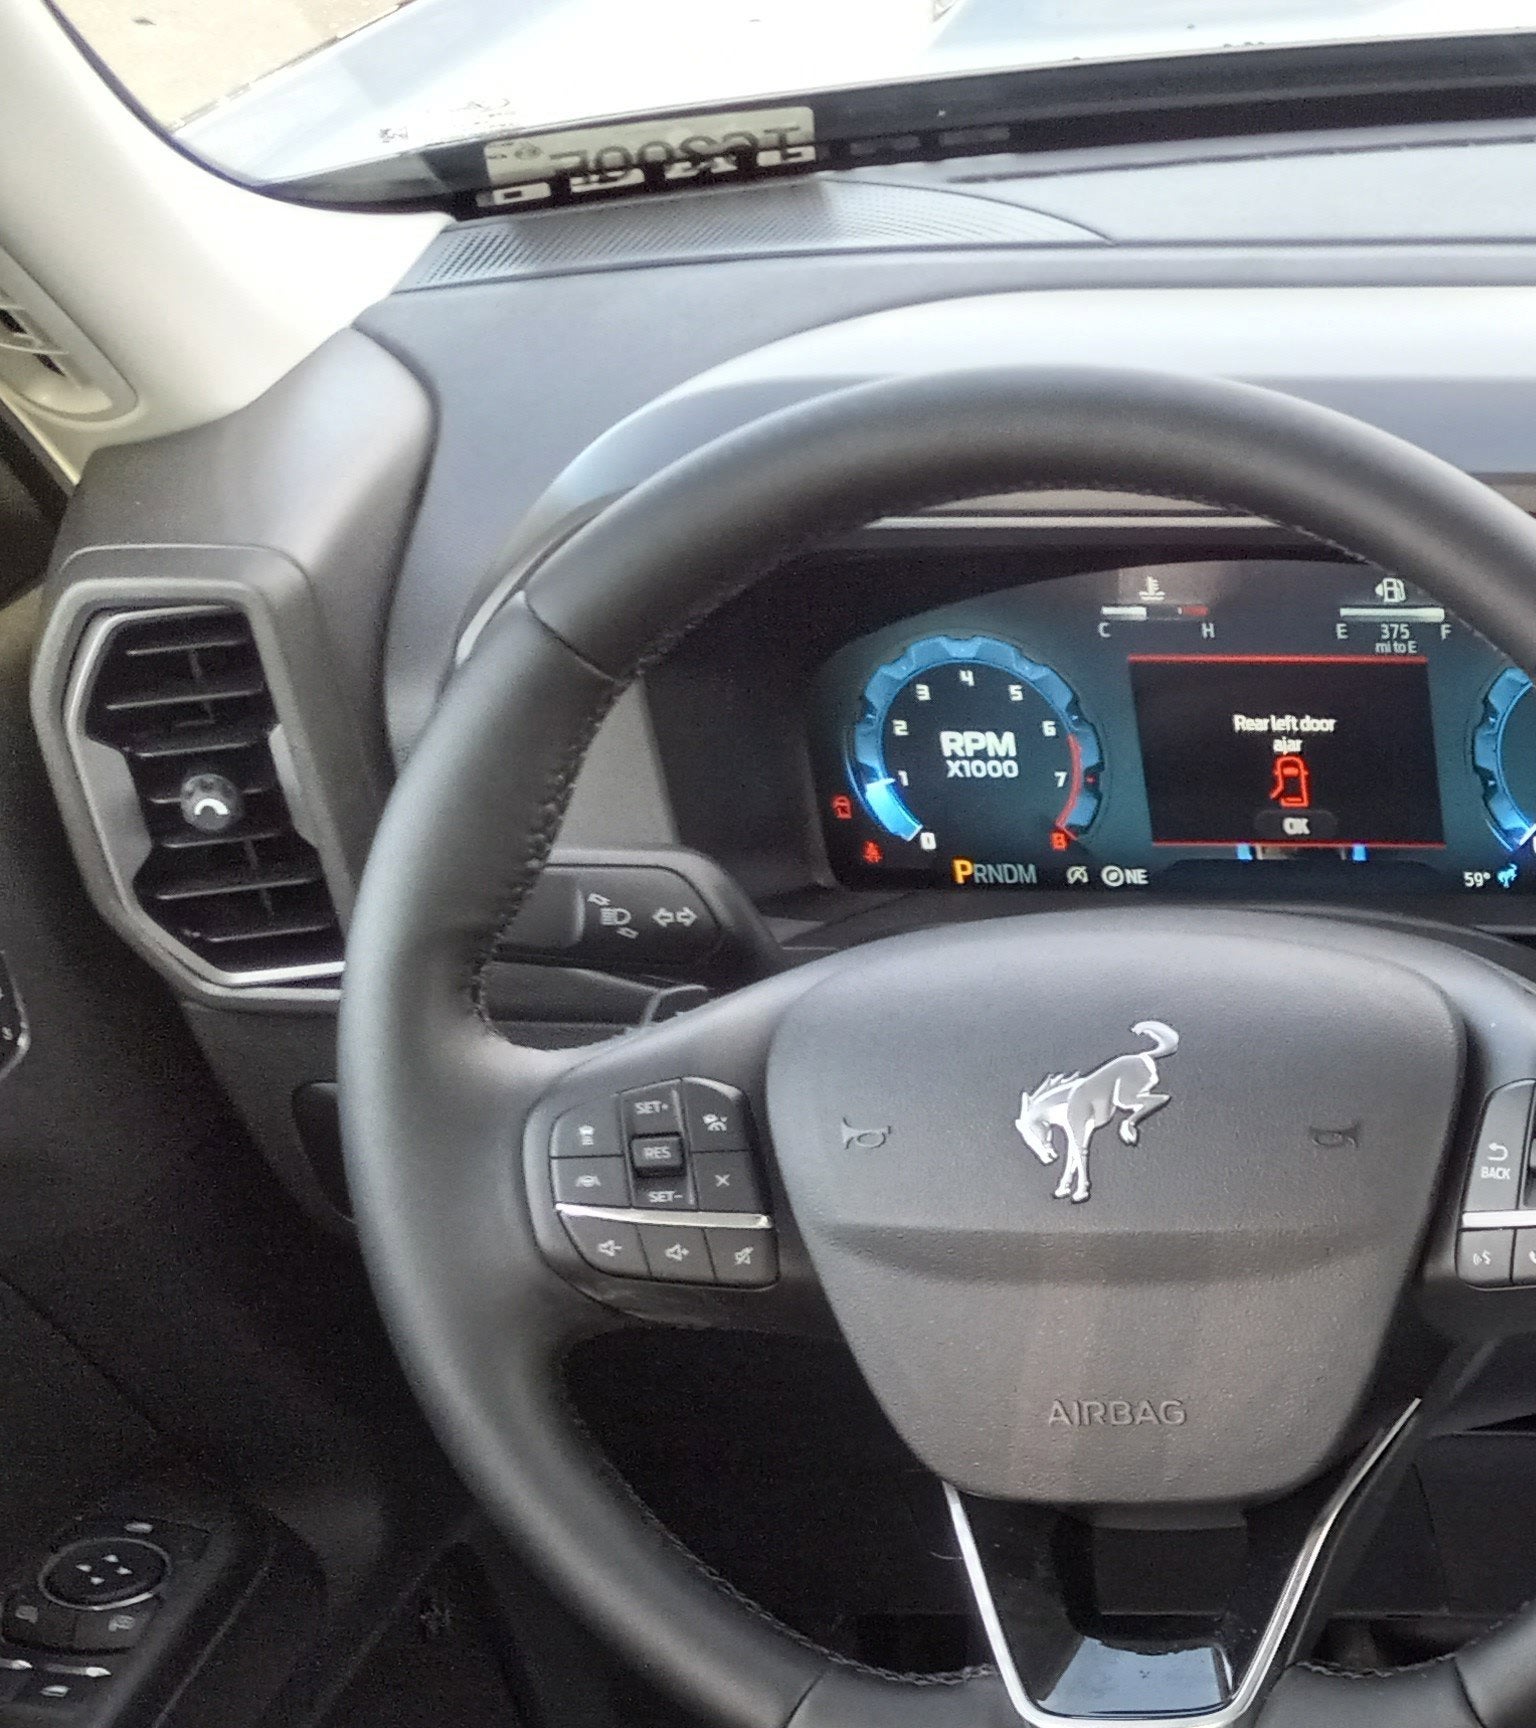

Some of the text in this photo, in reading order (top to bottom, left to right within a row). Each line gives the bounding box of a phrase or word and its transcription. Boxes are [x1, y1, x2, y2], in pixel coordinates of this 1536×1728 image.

[1098, 624, 1111, 638] C
[1202, 624, 1215, 638] H
[1336, 625, 1348, 639] E
[1380, 624, 1410, 640] 375
[1441, 625, 1451, 639] F
[1375, 641, 1391, 653] mi
[1393, 641, 1405, 653] to
[960, 670, 975, 686] 4
[916, 684, 931, 701] 3
[1008, 685, 1023, 701] 5
[893, 719, 908, 735] 2
[1042, 720, 1056, 737] 6
[1234, 714, 1336, 731] Rear left door
[940, 731, 1016, 757] RPM
[1273, 736, 1303, 755] ajar
[947, 760, 1018, 778] X1000
[898, 771, 909, 786] 1
[1054, 772, 1067, 787] 7
[1282, 818, 1310, 834] OK
[920, 832, 936, 849] 0
[1128, 867, 1148, 886] NE
[644, 1146, 671, 1159] RES
[1480, 1166, 1511, 1180] BACK
[1048, 1399, 1187, 1426] AIRBAG
